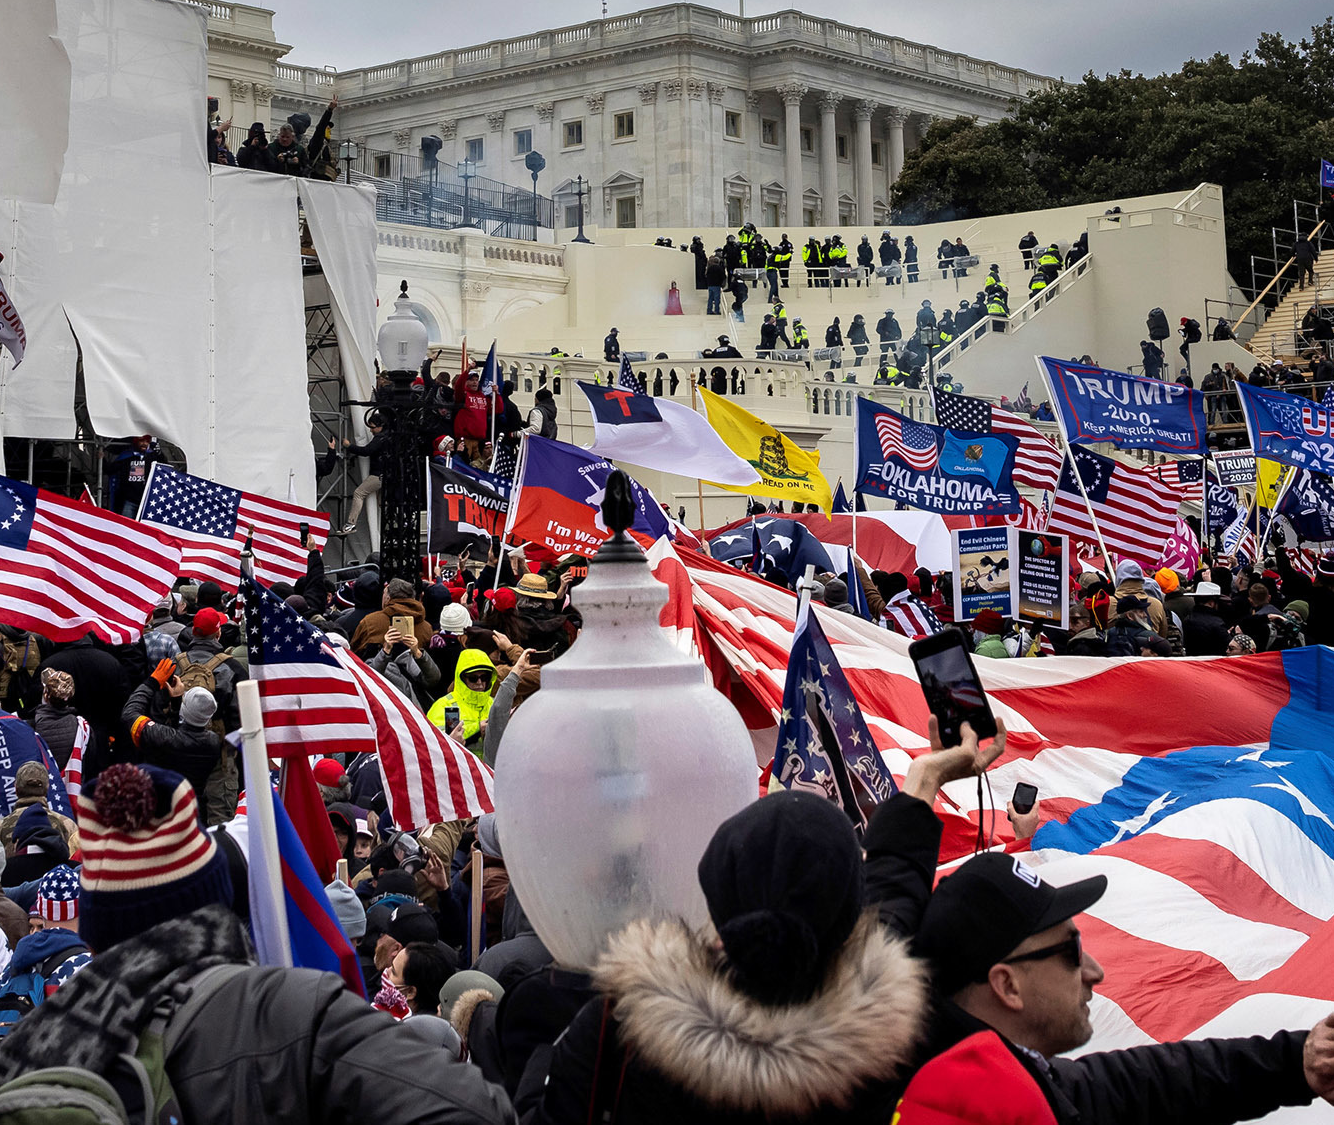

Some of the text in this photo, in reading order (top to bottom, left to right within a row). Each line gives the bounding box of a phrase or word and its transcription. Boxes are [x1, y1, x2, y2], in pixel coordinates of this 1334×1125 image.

[1065, 370, 1185, 406] TRUMP
[1083, 420, 1192, 442] KEEP AMERICA GREAT!
[577, 461, 608, 476] Saved
[953, 465, 985, 473] OKLAHOMA
[1218, 457, 1256, 471] TRUMP
[881, 460, 998, 502] OKLAHOMA
[1229, 473, 1253, 482] 2020
[803, 483, 815, 491] ME
[887, 484, 984, 511] FOR TRUMP
[546, 520, 572, 538] I'm
[545, 536, 583, 553] Don't
[959, 544, 992, 553] Communist
[1024, 562, 1051, 571] COMMUNISM
[1045, 572, 1059, 580] WORLD
[1037, 583, 1058, 591] ELECTION
